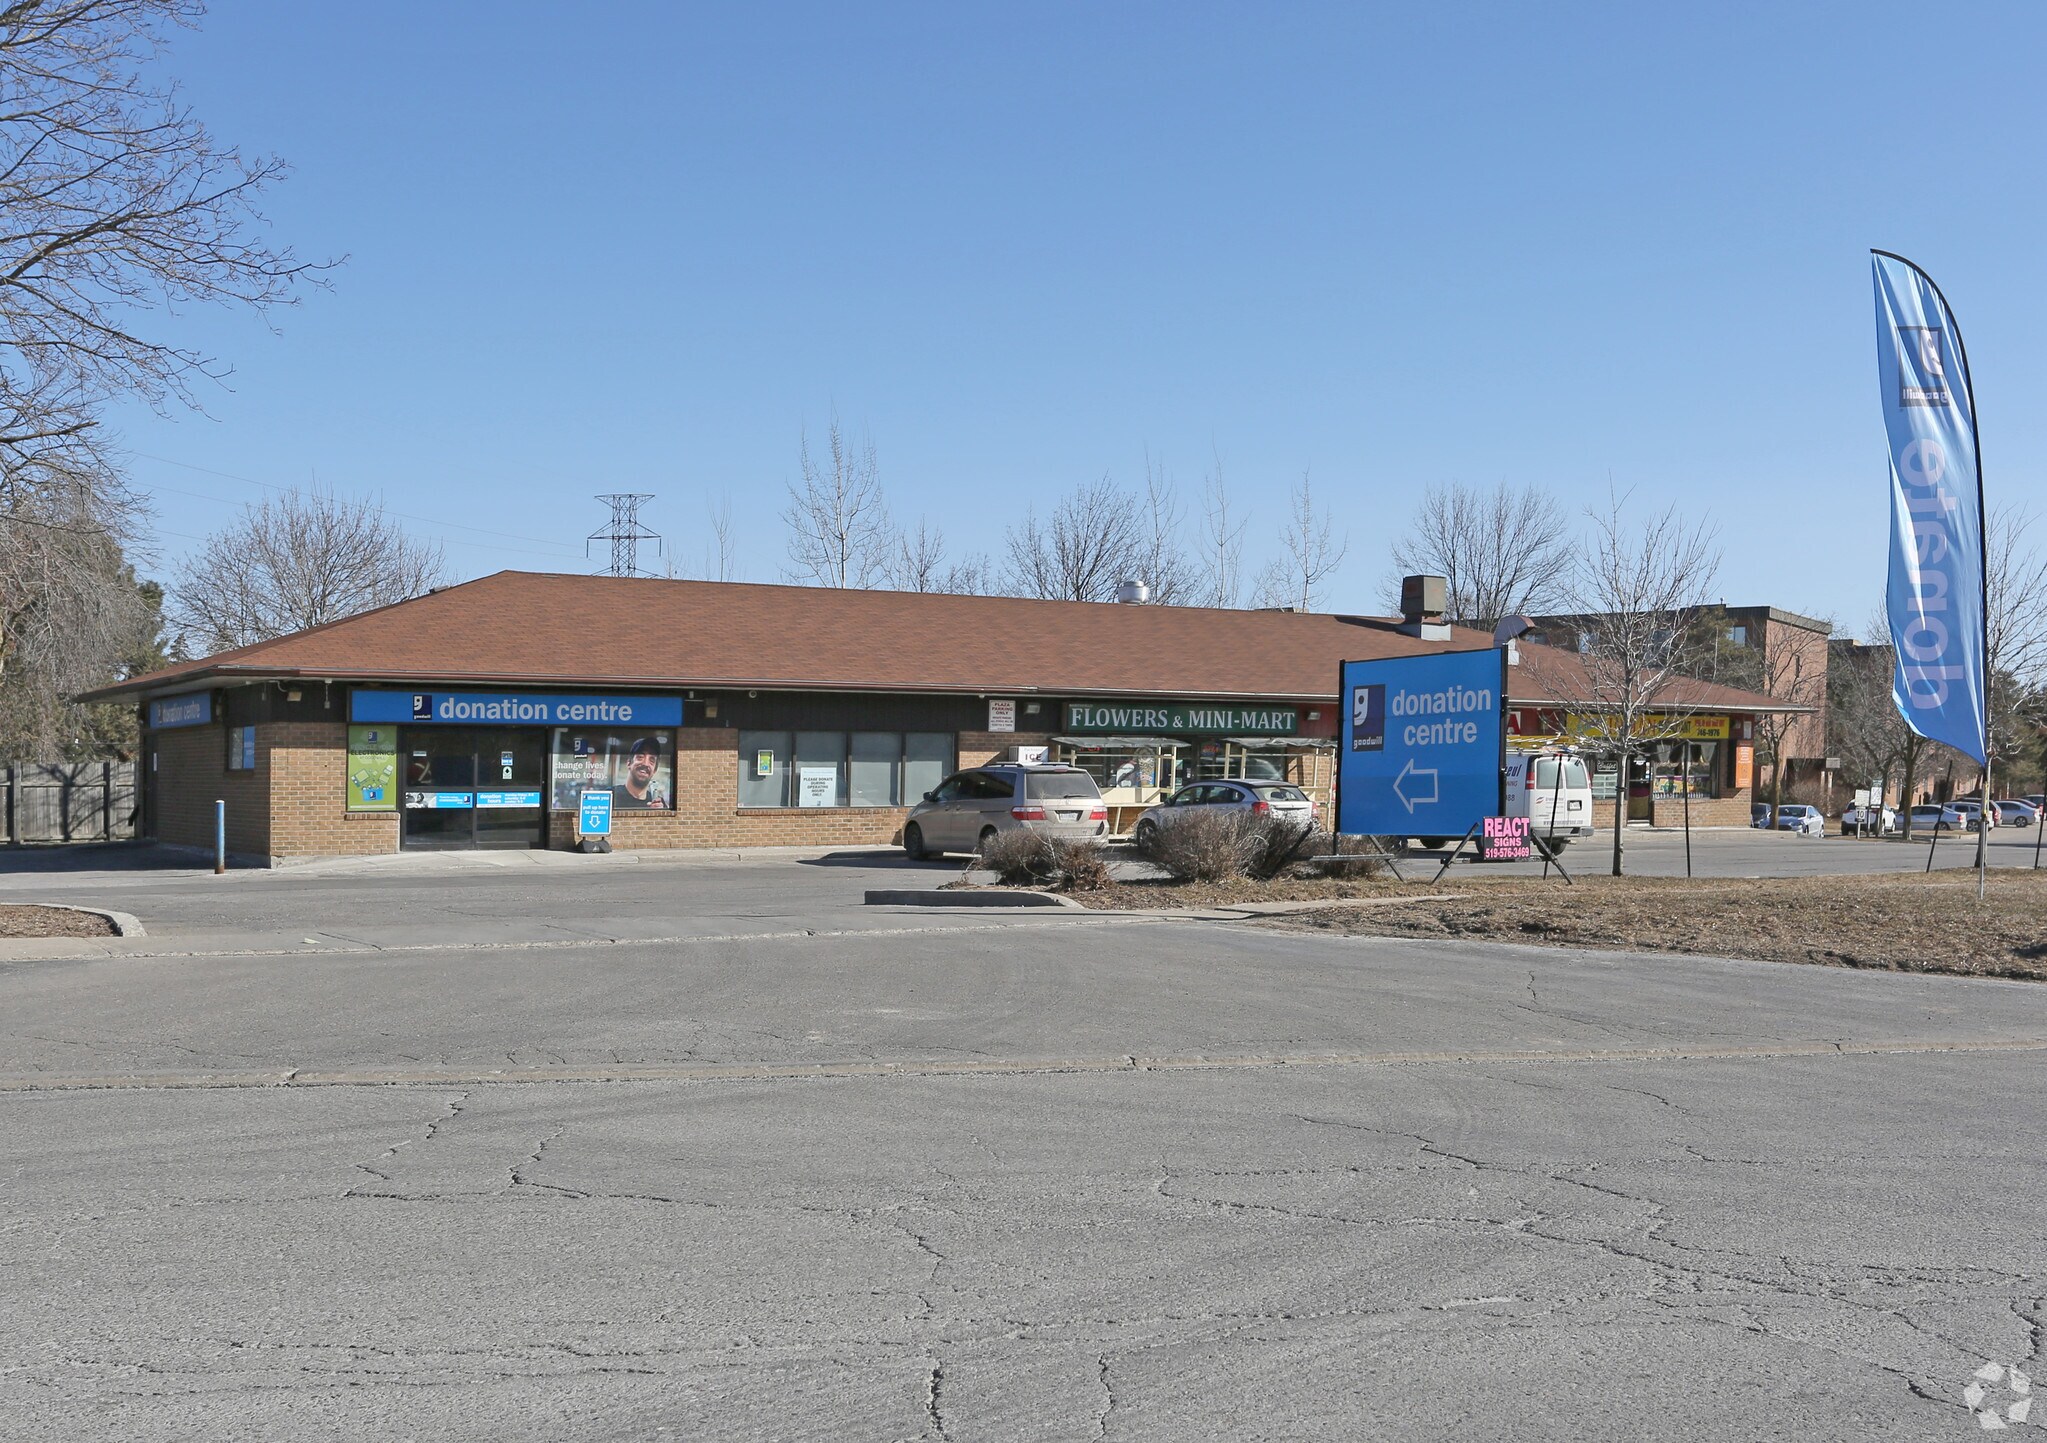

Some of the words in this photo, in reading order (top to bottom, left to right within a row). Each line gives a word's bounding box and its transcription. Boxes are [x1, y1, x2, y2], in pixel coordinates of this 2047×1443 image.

[440, 697, 548, 719] donation
[556, 701, 632, 721] centre
[1392, 685, 1491, 716] donation
[1071, 708, 1168, 728] FLOWERS
[1172, 715, 1183, 728] &
[1188, 710, 1295, 730] MINI-MART
[1353, 736, 1383, 749] goodwill
[1404, 718, 1477, 746] centre
[583, 771, 608, 780] today.
[1484, 817, 1530, 838] REACT
[1485, 847, 1529, 858] 519-576-3469
[1493, 837, 1521, 847] SIGNS
